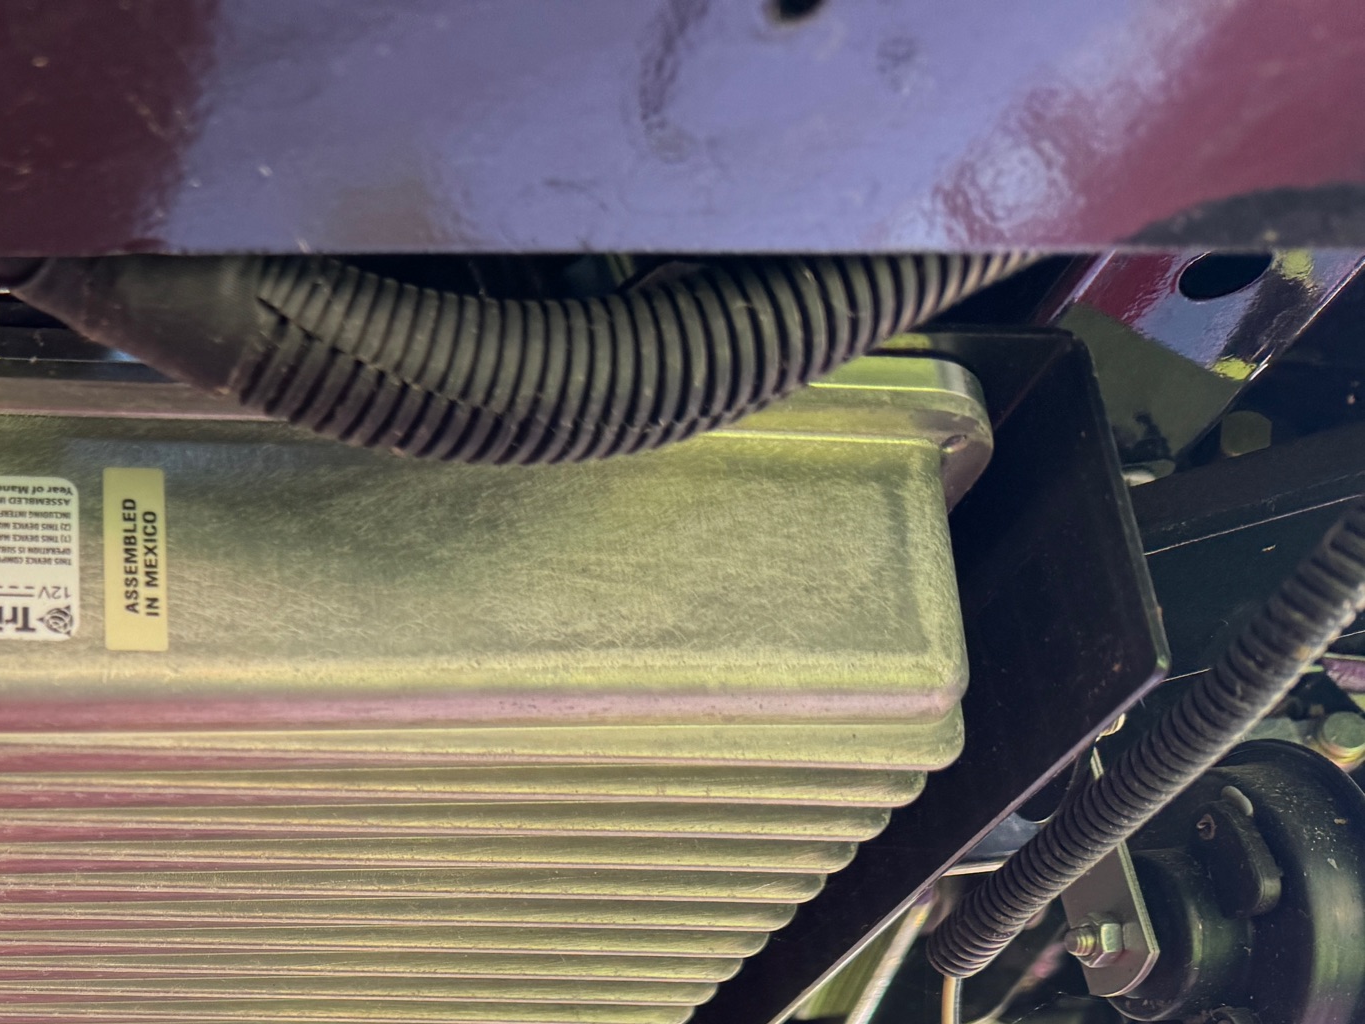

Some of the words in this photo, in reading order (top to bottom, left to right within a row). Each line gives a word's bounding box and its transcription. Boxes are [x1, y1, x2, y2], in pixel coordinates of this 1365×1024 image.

[32, 486, 44, 495] of
[47, 486, 73, 495] Year
[8, 496, 71, 505] ASSEMBLED
[28, 511, 71, 520] INCLUDING
[12, 523, 39, 531] DEVICE
[41, 523, 58, 531] THIS
[12, 534, 39, 542] DEVICE
[41, 535, 59, 543] THIS
[27, 547, 71, 555] OPERATION
[142, 511, 159, 588] MEXICO
[121, 498, 140, 614] ASSEMBLED
[25, 557, 53, 565] DEVICE
[38, 586, 71, 599] 12V
[145, 597, 160, 617] IN
